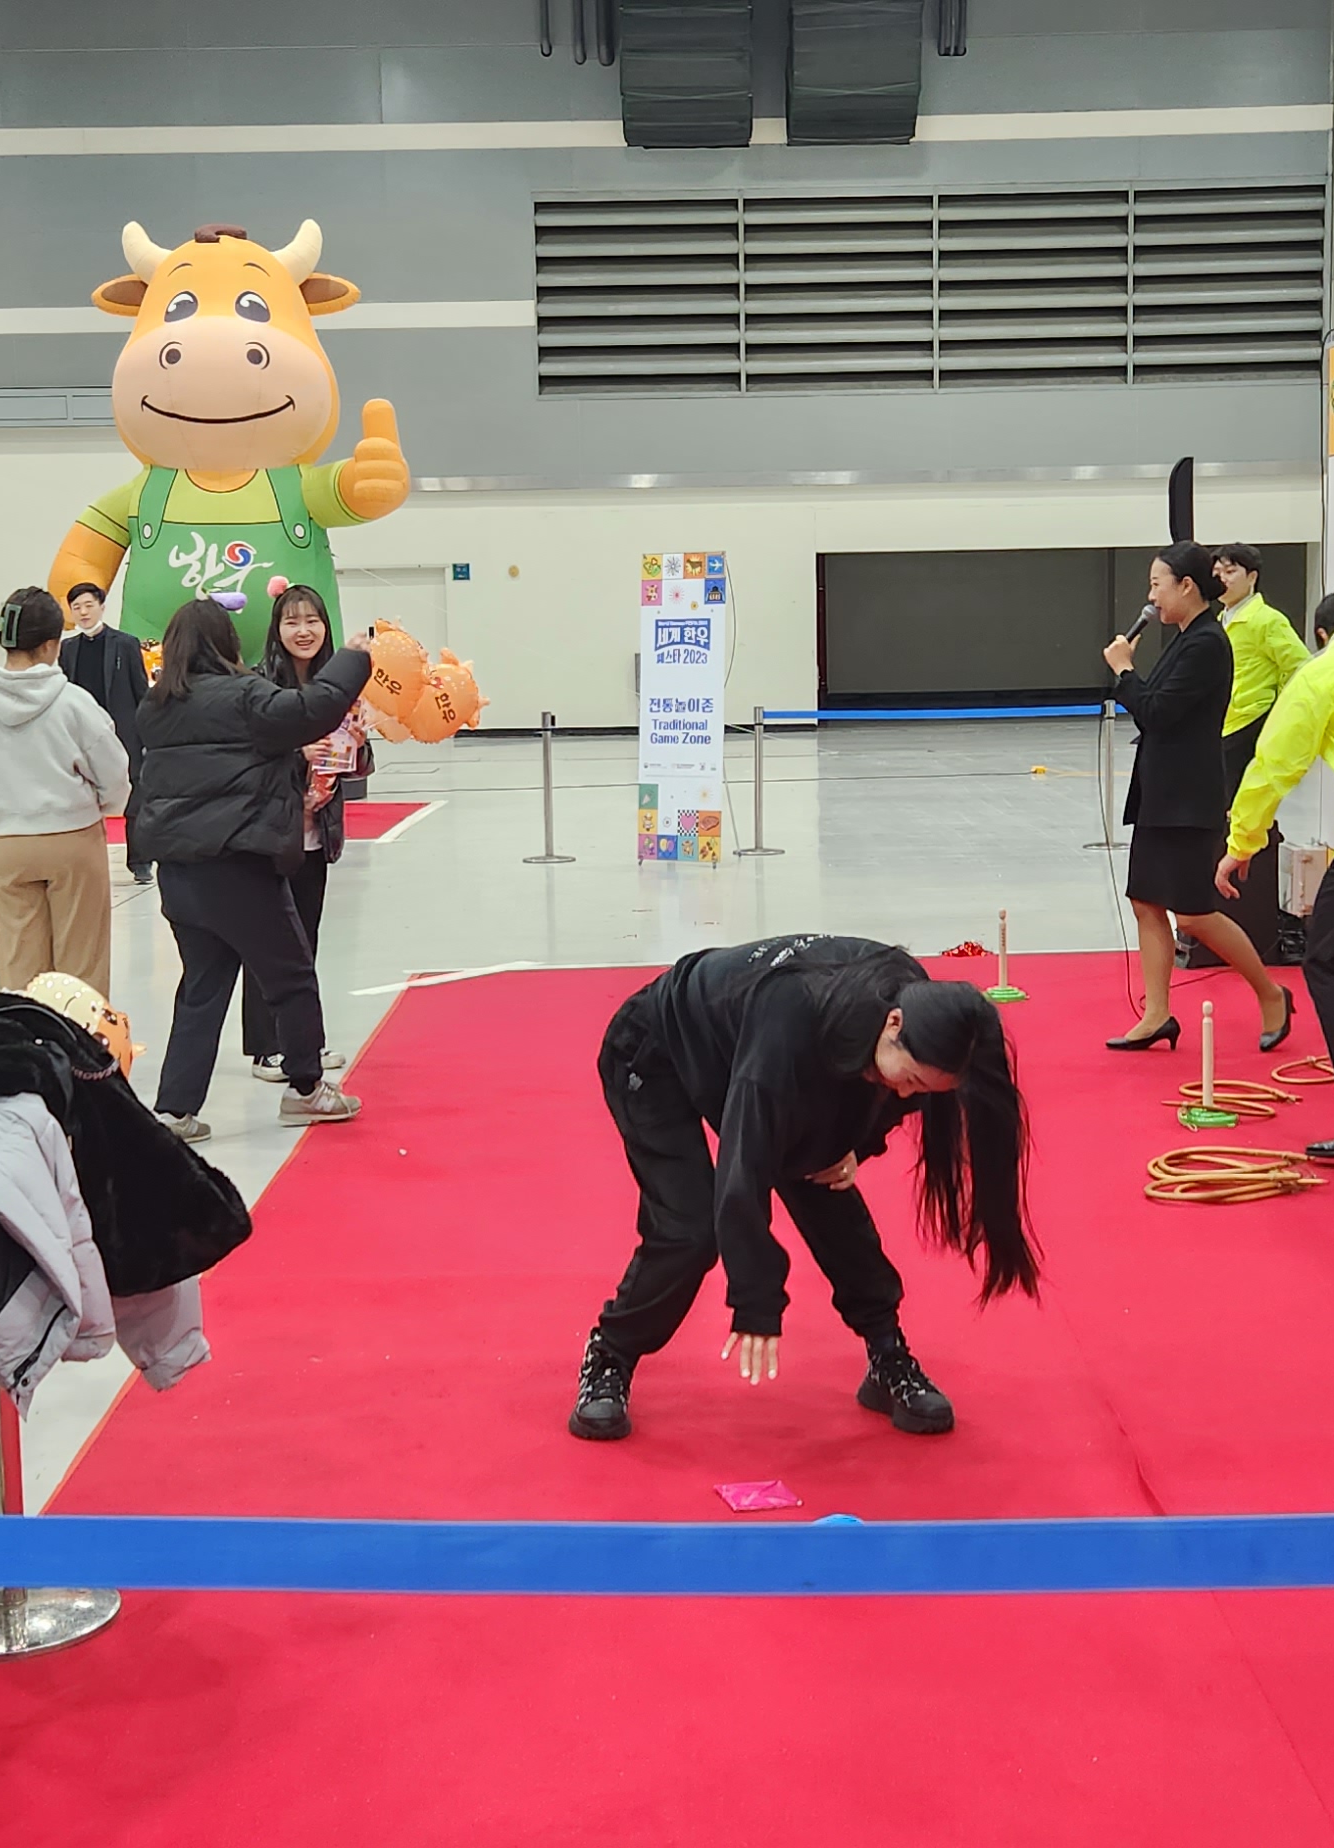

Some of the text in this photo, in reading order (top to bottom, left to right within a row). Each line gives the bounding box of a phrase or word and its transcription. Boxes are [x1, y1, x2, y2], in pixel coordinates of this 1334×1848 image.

[657, 626, 709, 648] 세계 한우
[683, 648, 708, 664] 2023
[373, 667, 403, 696] 한우
[434, 692, 457, 724] 한우
[651, 718, 708, 731] Traditional
[650, 731, 712, 745] Game Zone
